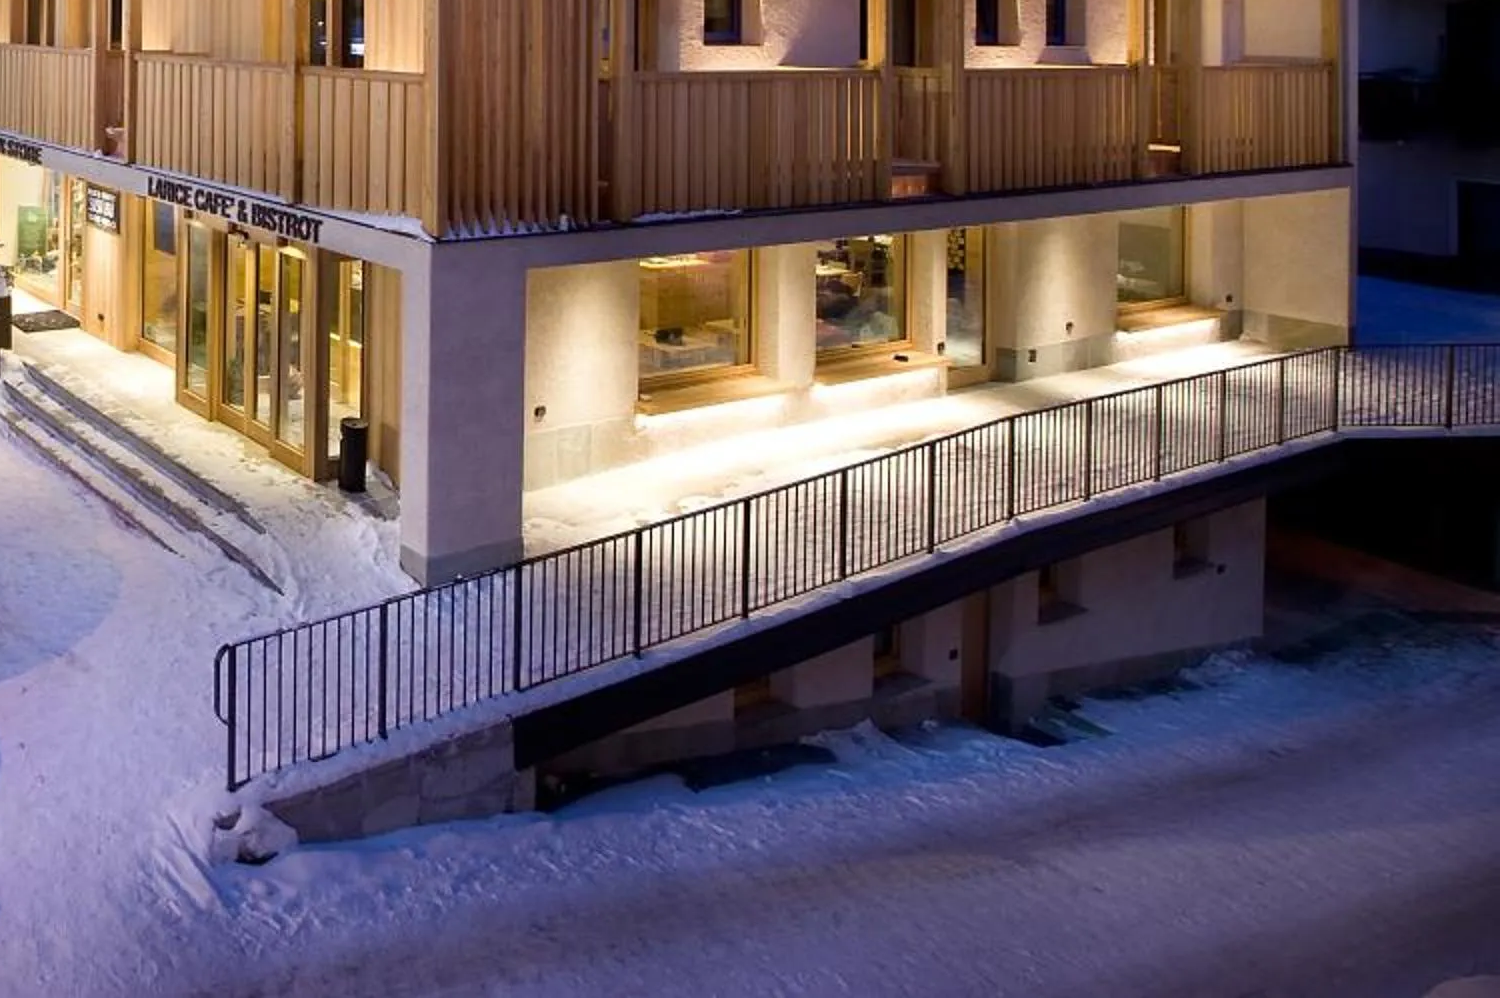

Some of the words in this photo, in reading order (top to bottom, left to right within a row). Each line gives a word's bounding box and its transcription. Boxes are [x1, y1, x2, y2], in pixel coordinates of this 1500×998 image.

[147, 175, 193, 207] LARICE
[237, 199, 248, 223] &
[251, 202, 323, 244] BISTROT
